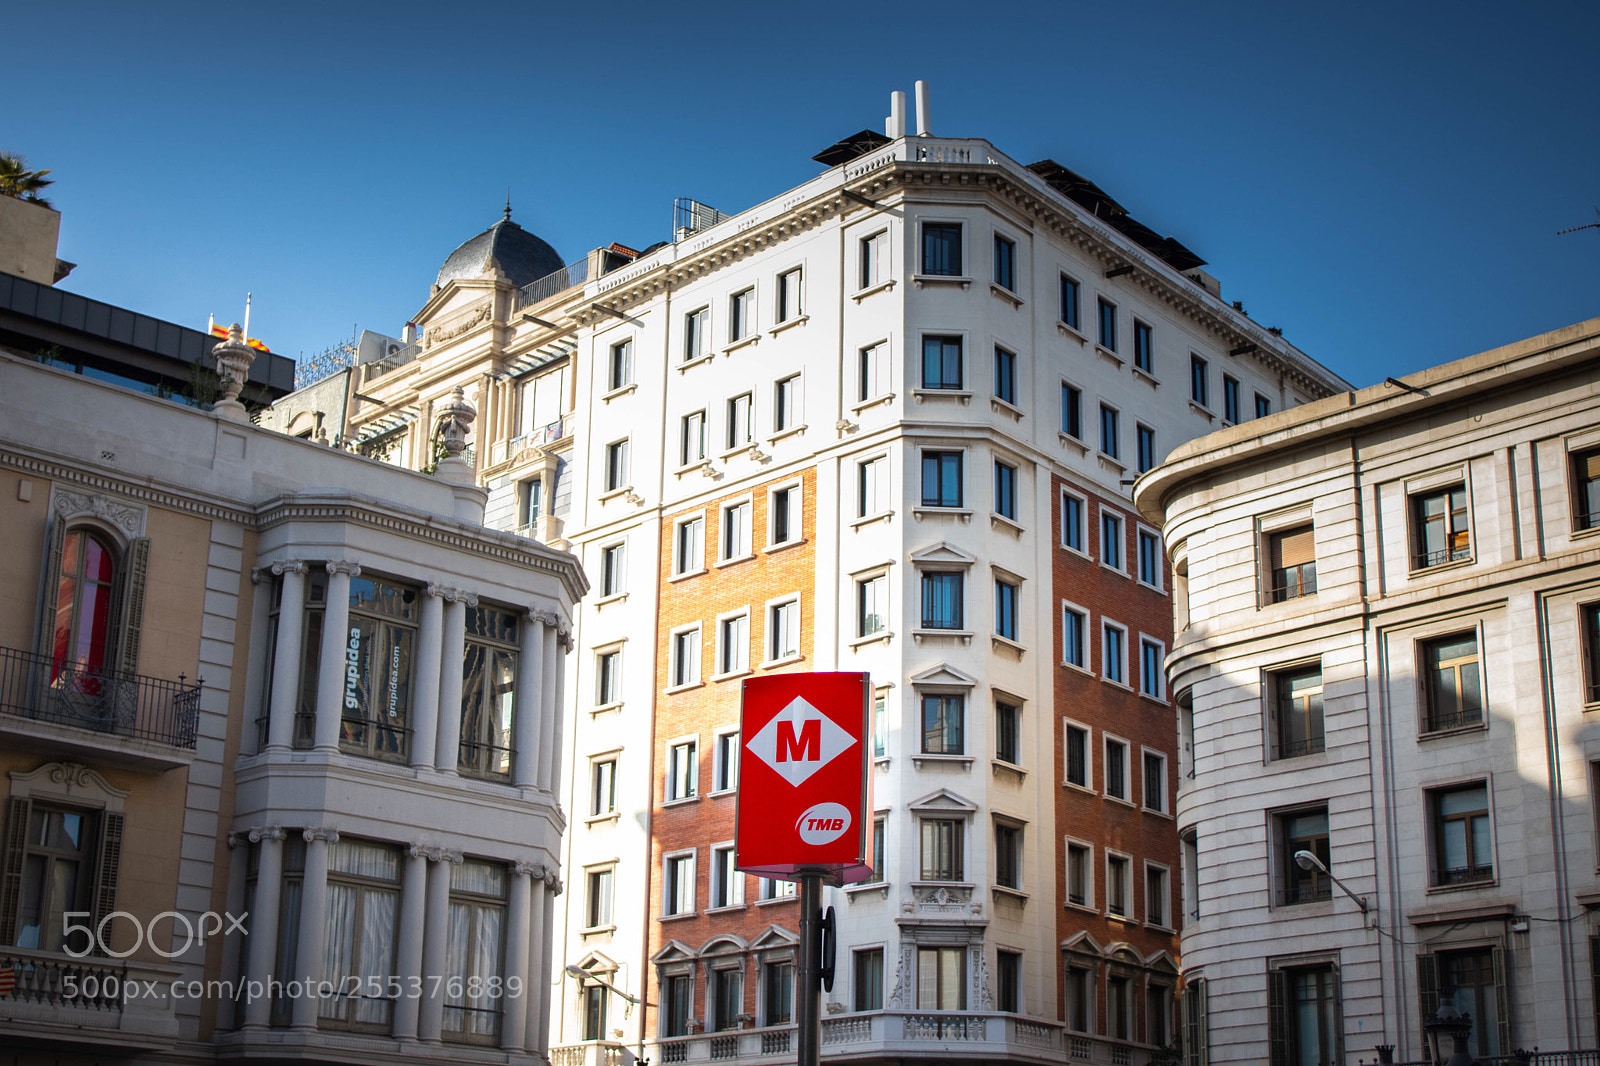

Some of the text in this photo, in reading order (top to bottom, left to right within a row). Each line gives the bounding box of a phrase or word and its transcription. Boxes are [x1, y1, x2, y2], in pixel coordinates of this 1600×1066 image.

[345, 628, 361, 709] grupidea
[389, 646, 400, 717] grupidea.com
[776, 719, 821, 763] M
[807, 818, 844, 831] TMB
